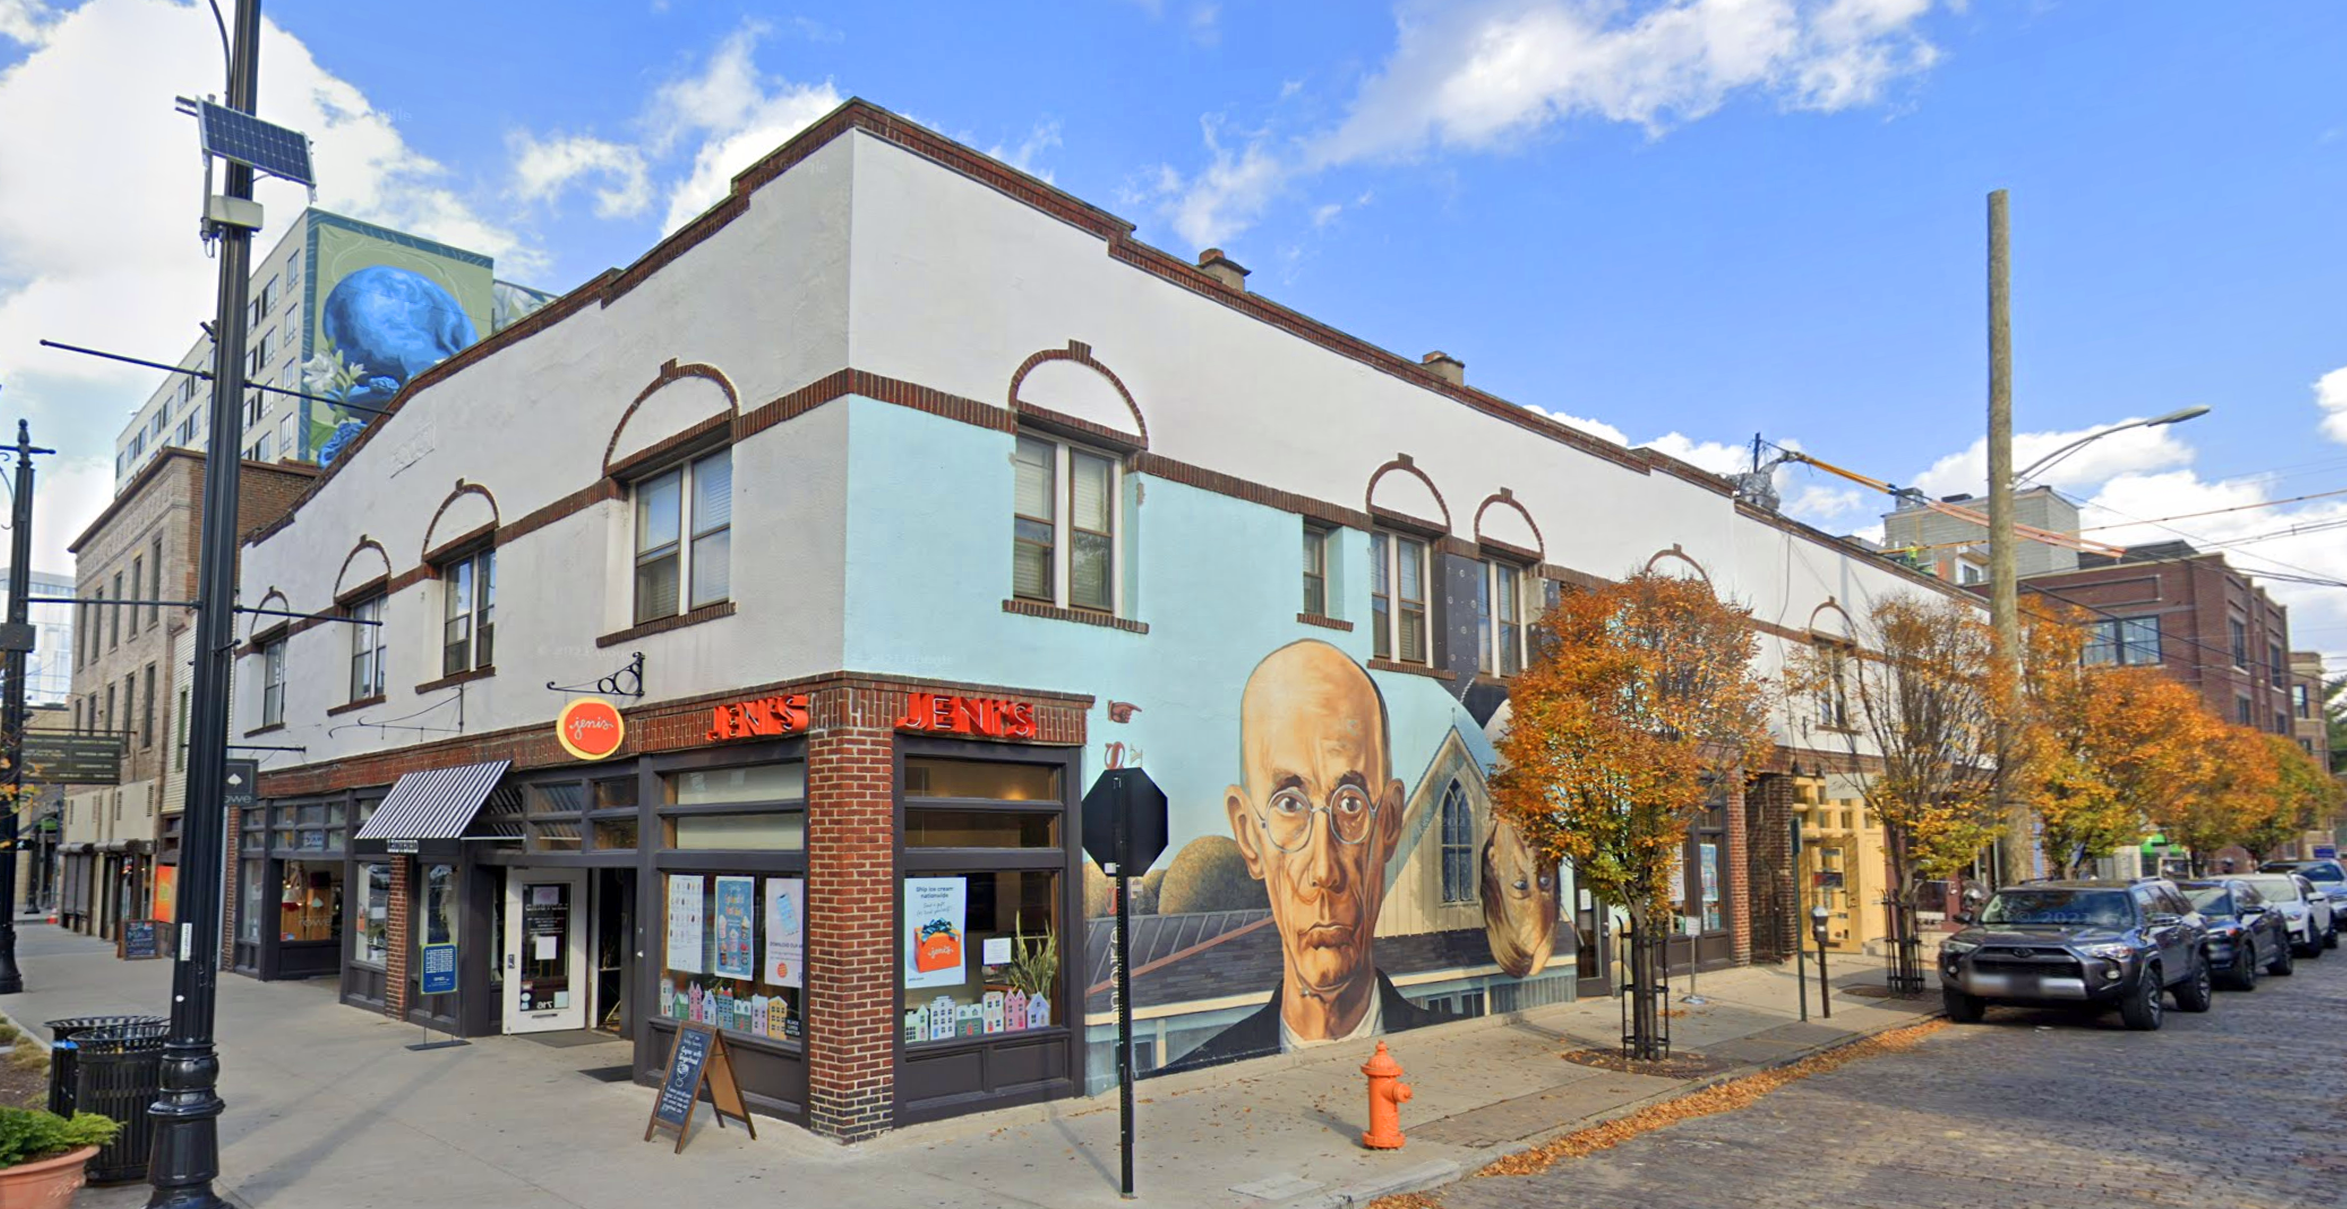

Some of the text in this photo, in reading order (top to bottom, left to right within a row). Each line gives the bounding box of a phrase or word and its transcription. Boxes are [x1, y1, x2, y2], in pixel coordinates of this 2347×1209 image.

[706, 694, 809, 742] JENI'S
[895, 692, 1036, 738] JENI'S
[224, 795, 252, 804] owe
